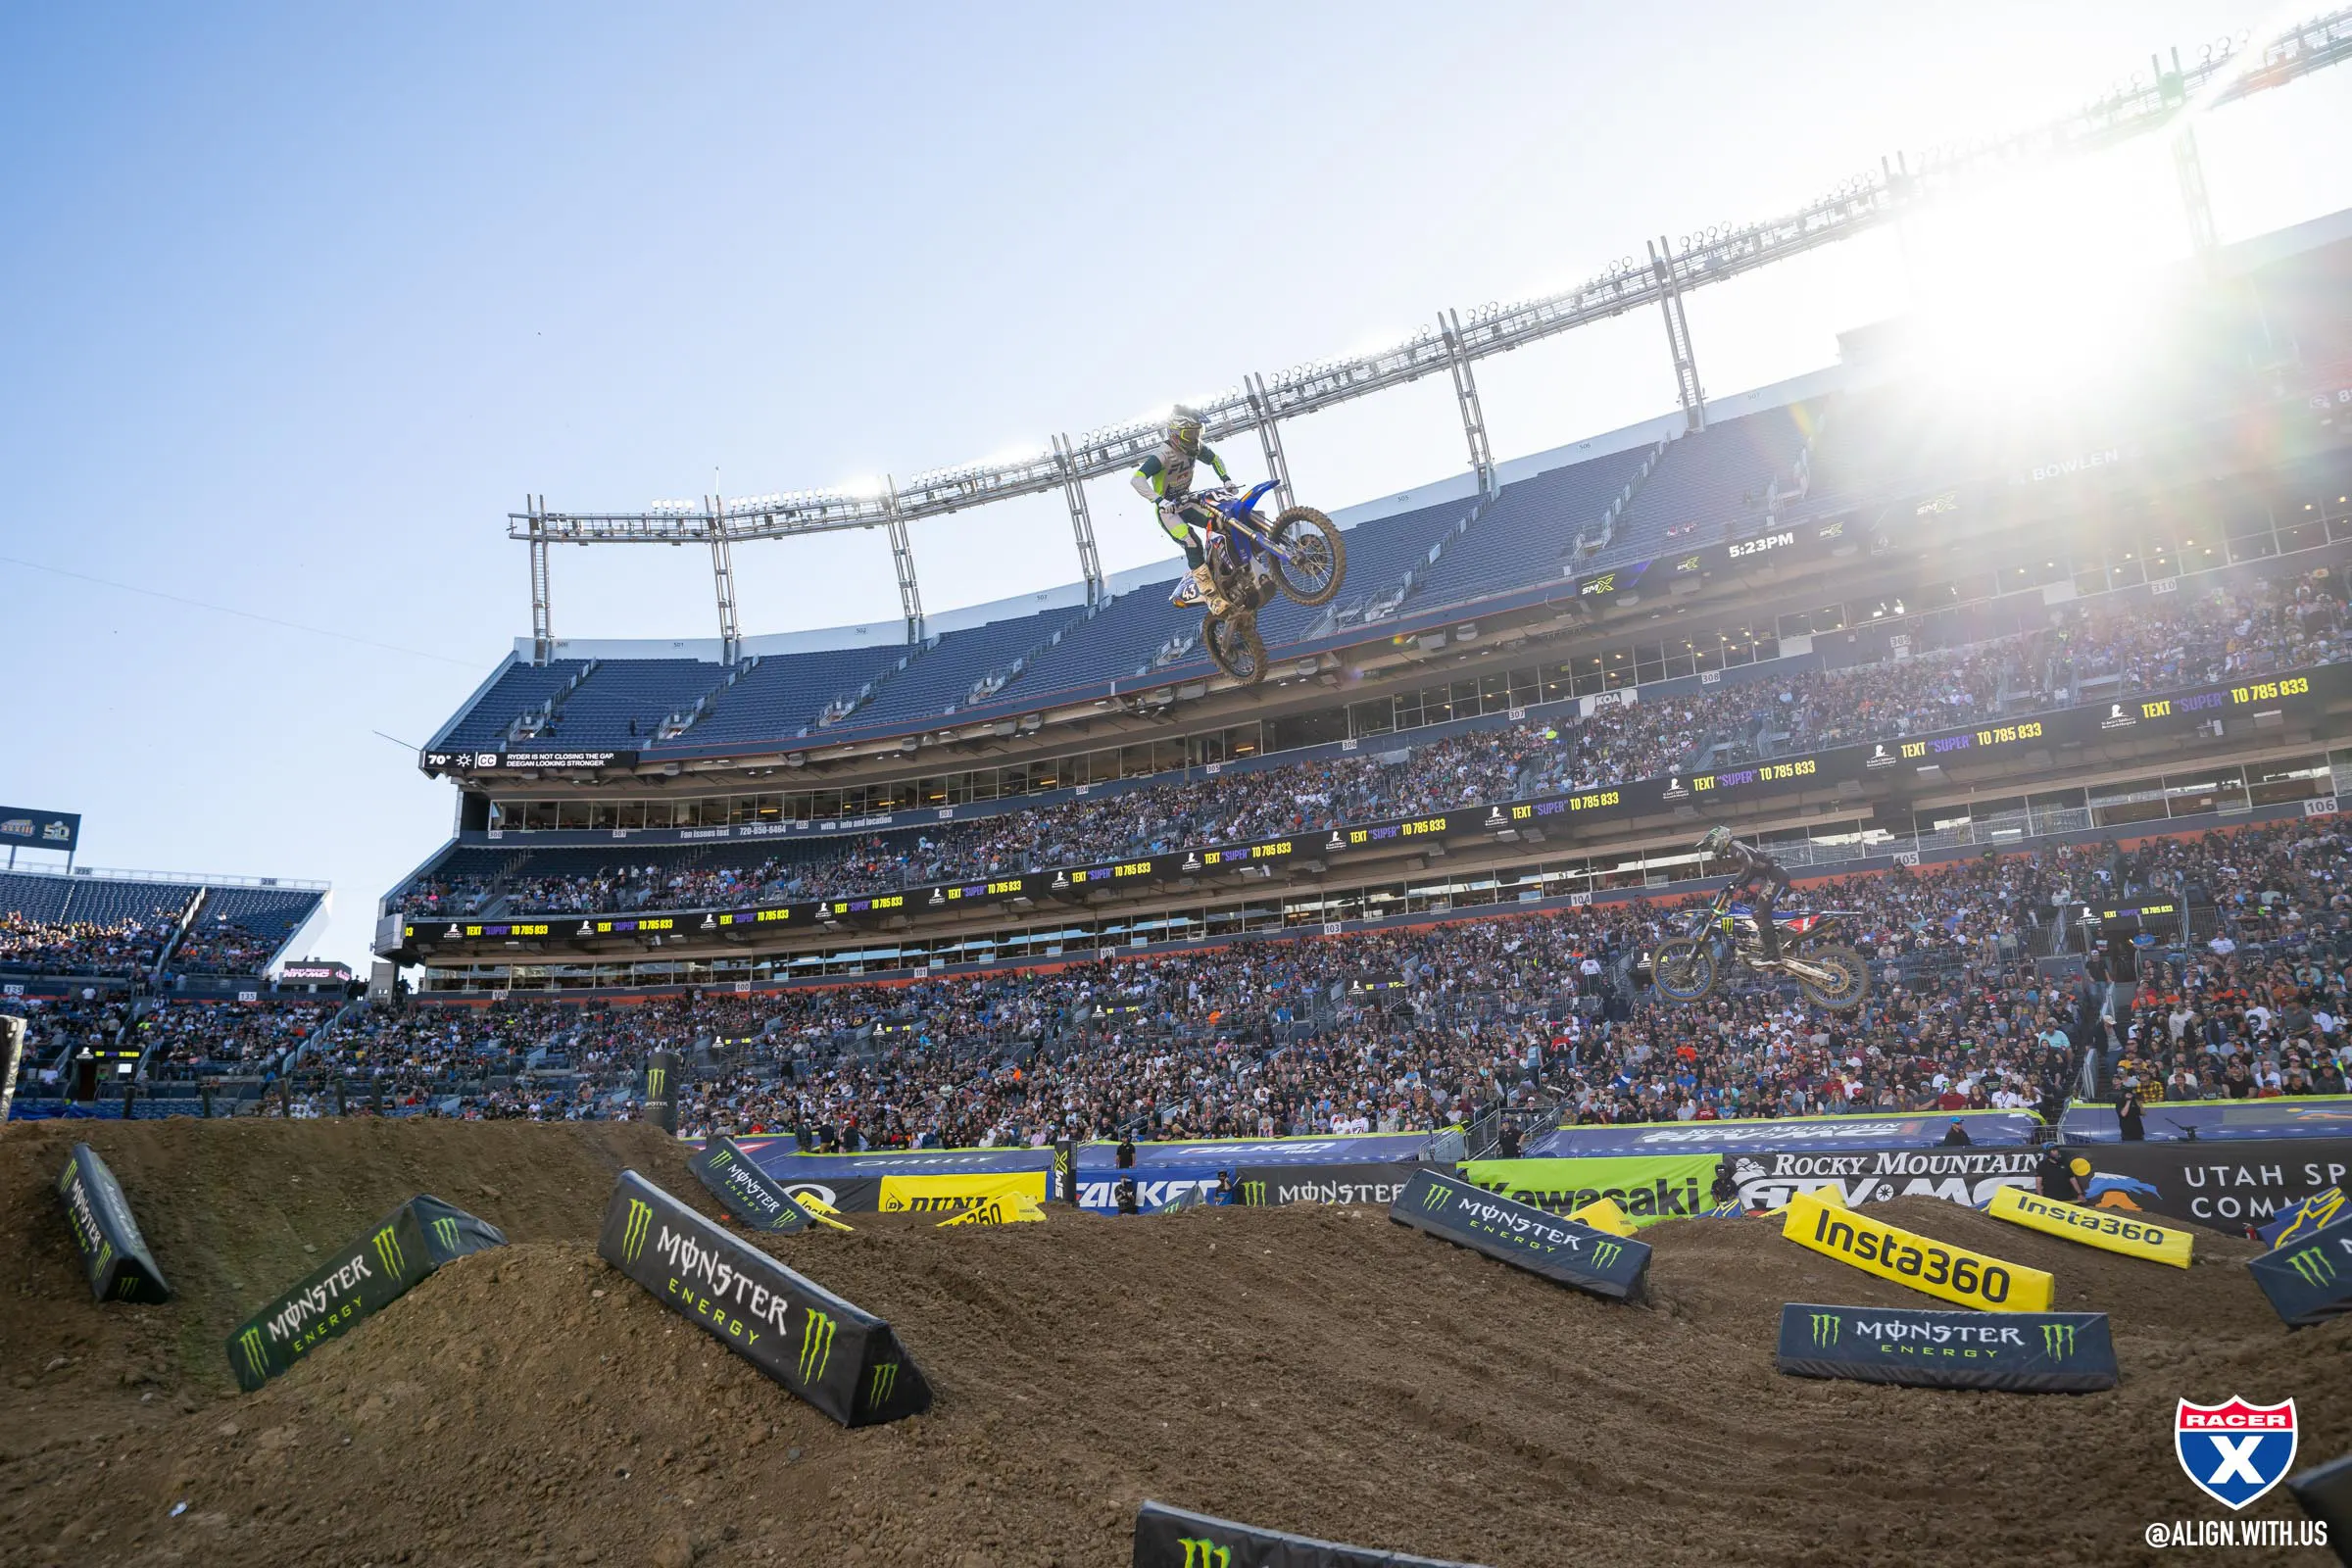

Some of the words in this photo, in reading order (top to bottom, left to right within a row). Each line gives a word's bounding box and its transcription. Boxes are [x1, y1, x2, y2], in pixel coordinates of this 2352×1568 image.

[2032, 448, 2119, 481] BOWLEN
[1729, 532, 1794, 558] 5:23PM
[1182, 584, 1197, 600] 43
[1582, 576, 1615, 595] SMX
[1702, 672, 1720, 684] 308
[1595, 693, 1621, 706] KOA
[2141, 701, 2171, 719] TEXT
[2230, 688, 2248, 705] TO
[2249, 682, 2278, 701] 785
[2280, 677, 2309, 697] 833
[1509, 710, 1525, 719] 307
[1343, 741, 1357, 750] 306
[1901, 742, 1926, 758] TEXT
[1977, 730, 1991, 745] TO
[1993, 726, 2016, 743] 785
[2018, 721, 2042, 740] 833
[480, 756, 495, 765] CC
[1206, 764, 1220, 773] 305
[1693, 775, 1715, 791] TEXT
[1759, 767, 1773, 781] TO
[1774, 763, 1793, 778] 785
[1795, 760, 1816, 775] 833
[1512, 806, 1532, 819] TEXT
[1570, 798, 1582, 810] TO
[1582, 795, 1599, 808] 785
[1600, 792, 1620, 807] 833
[2306, 800, 2335, 815] 106
[840, 820, 852, 829] info
[853, 818, 864, 828] and
[865, 815, 893, 827] location
[1349, 830, 1367, 844] TEXT
[1401, 823, 1411, 836] TO
[1412, 821, 1428, 834] 785
[1429, 818, 1446, 831] 833
[1204, 852, 1220, 864] TEXT
[1251, 846, 1261, 858] TO
[1261, 845, 1276, 857] 785
[1277, 842, 1292, 855] 833
[1072, 871, 1087, 883] TEXT
[1115, 866, 1123, 878] TO
[1123, 864, 1137, 876] 785
[1137, 862, 1152, 874] 833
[948, 888, 961, 900] TEXT
[988, 883, 996, 894] TO
[996, 882, 1008, 893] 785
[1008, 880, 1022, 891] 833
[1571, 894, 1591, 906] 104
[834, 903, 848, 914] TEXT
[871, 899, 879, 909] TO
[879, 898, 891, 908] 785
[891, 897, 904, 907] 833
[719, 914, 733, 925] TEXT
[1324, 924, 1341, 934] 103
[1101, 949, 1115, 958] 102
[914, 968, 928, 977] 101
[239, 992, 256, 1001] 135
[735, 983, 750, 992] 100
[1054, 1150, 1068, 1199] SMX
[1772, 1153, 1867, 1176] ROCKY
[1872, 1151, 2044, 1176] MOUNTAIN
[2184, 1164, 2284, 1187] UTAH
[2304, 1163, 2346, 1185] SP
[724, 1179, 760, 1213] ENERGY
[727, 1163, 780, 1213] MONSTER
[1458, 1198, 1581, 1251] MONSTER
[2017, 1196, 2164, 1246] Insta360
[1469, 1219, 1556, 1253] ENERGY
[1814, 1208, 2010, 1303] Insta360
[657, 1225, 789, 1337] MONSTER
[268, 1254, 372, 1343] MONSTER
[668, 1277, 760, 1346] ENERGY
[293, 1295, 362, 1352] ENERGY
[1856, 1319, 2026, 1347] MONSTER
[1881, 1345, 1998, 1358] ENERGY
